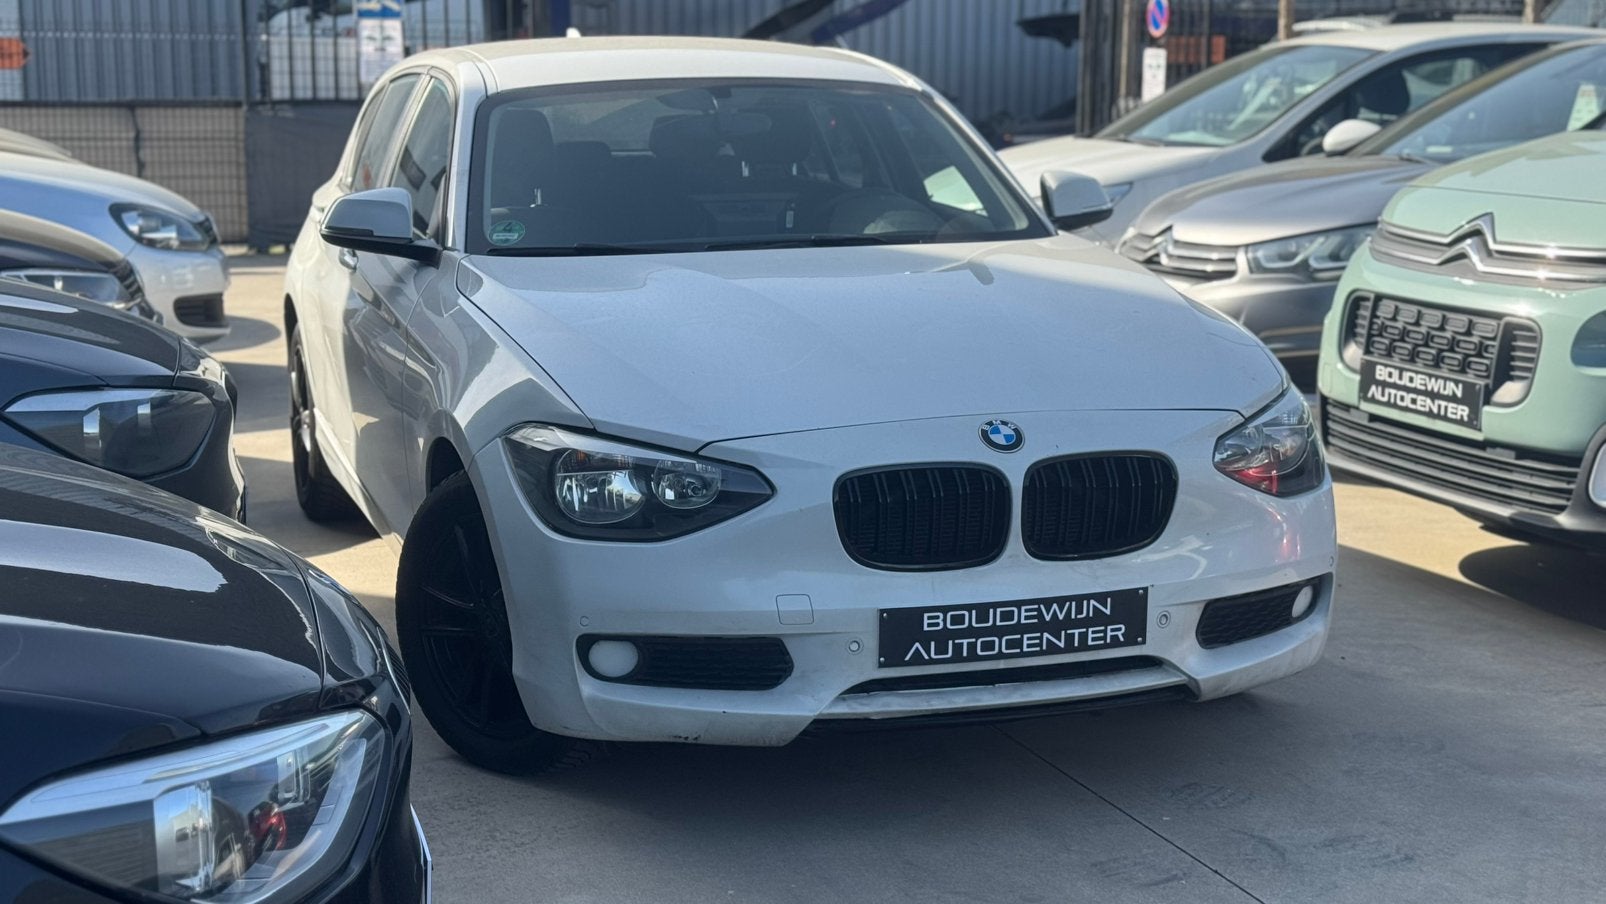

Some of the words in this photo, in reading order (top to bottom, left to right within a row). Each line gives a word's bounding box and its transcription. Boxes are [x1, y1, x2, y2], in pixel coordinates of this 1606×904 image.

[1374, 364, 1463, 398] BOUDEWIJN
[1367, 384, 1470, 421] AUTOCENTER
[922, 598, 1111, 631] BOUDEWIJN
[904, 624, 1126, 661] AUTOCENTER
